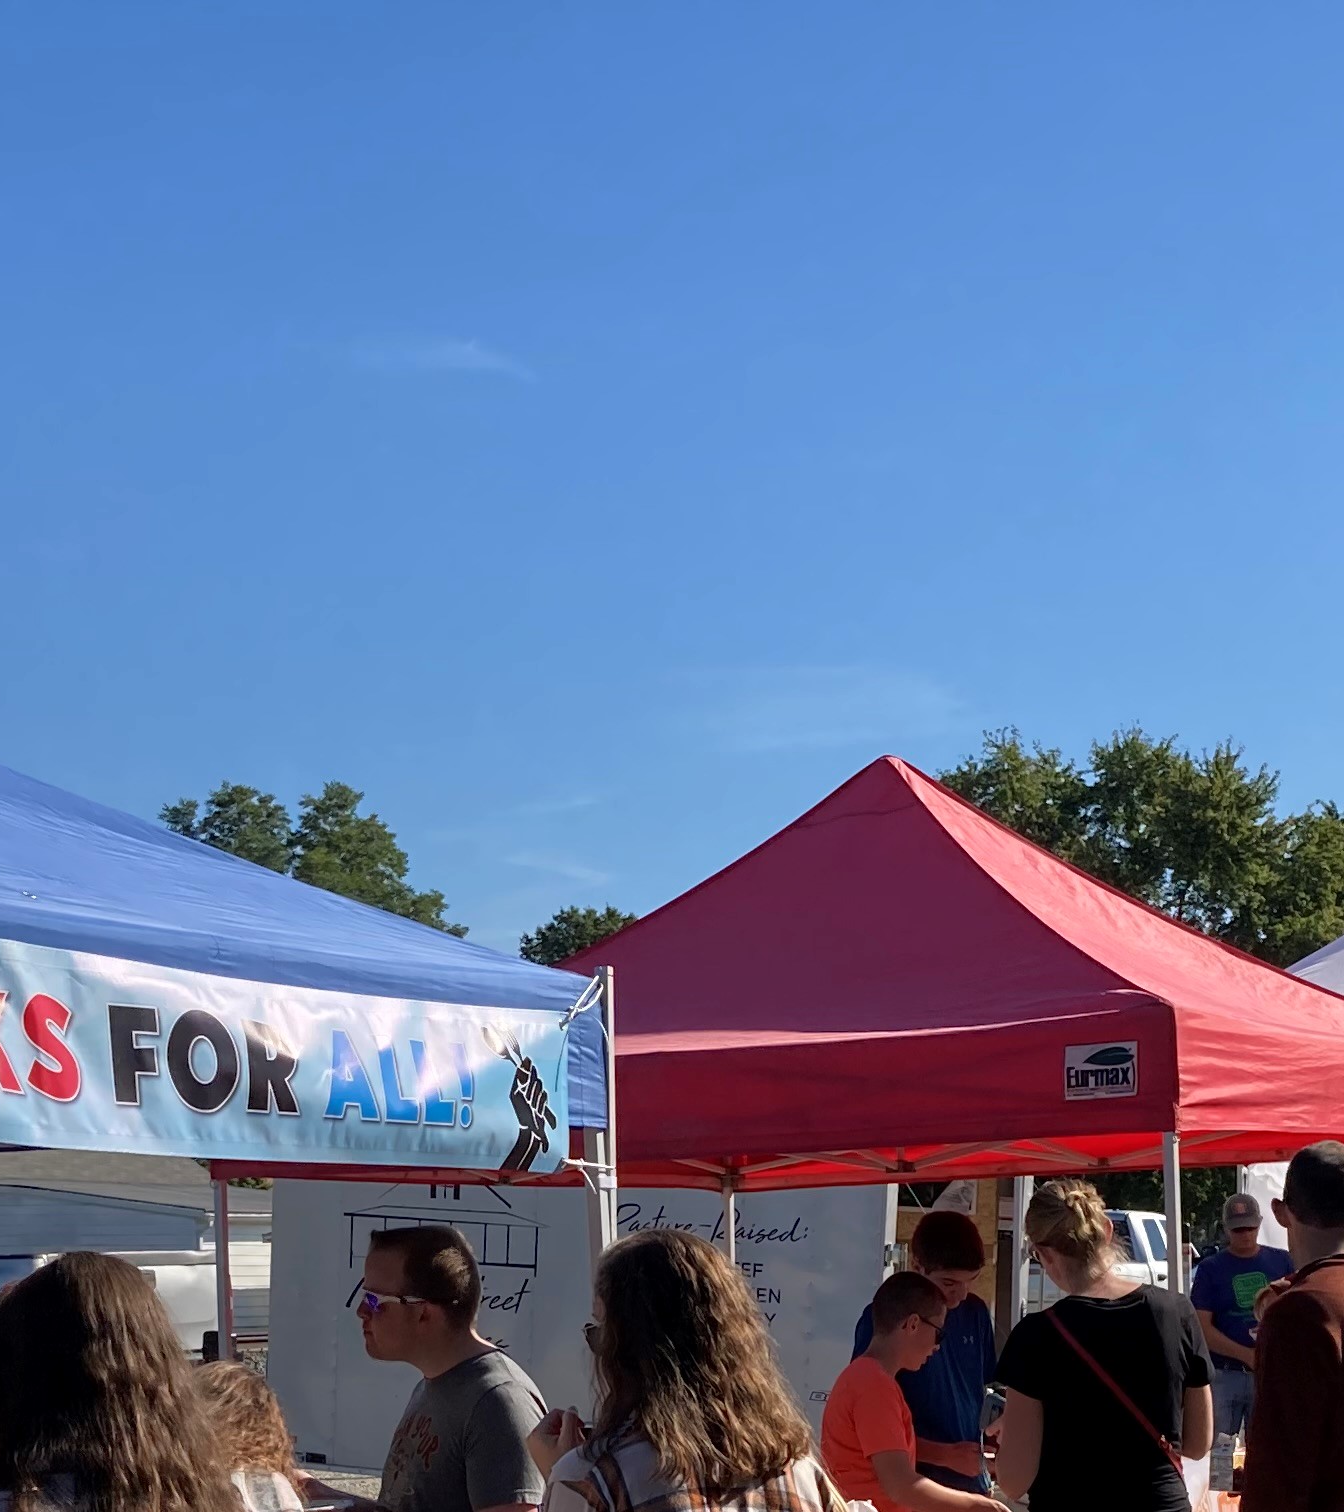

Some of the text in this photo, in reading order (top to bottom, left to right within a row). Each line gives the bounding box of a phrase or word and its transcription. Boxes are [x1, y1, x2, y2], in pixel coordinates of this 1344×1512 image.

[108, 1004, 301, 1116] FOR
[325, 1029, 475, 1129] ALL!
[1066, 1066, 1131, 1089] Eurmax
